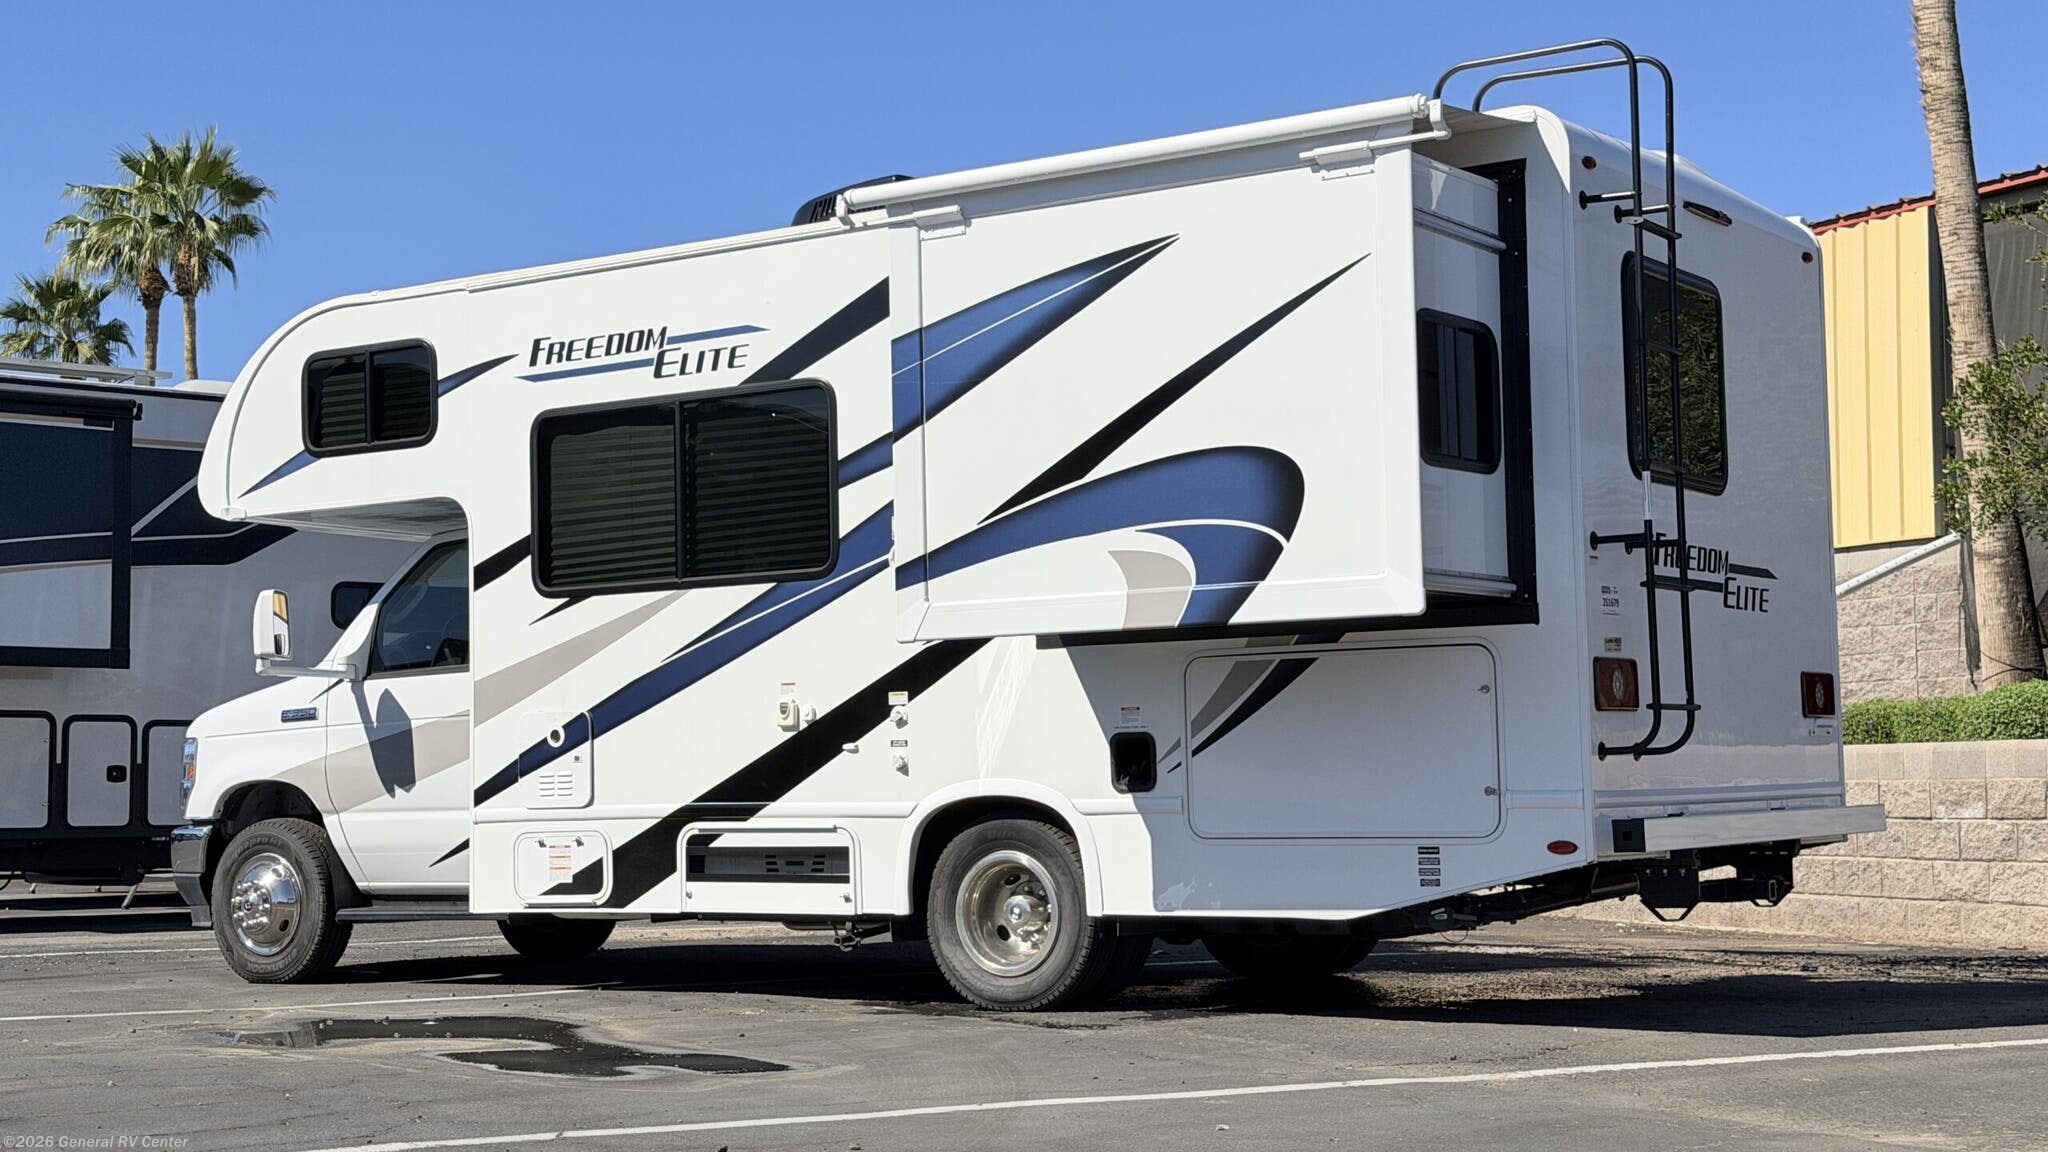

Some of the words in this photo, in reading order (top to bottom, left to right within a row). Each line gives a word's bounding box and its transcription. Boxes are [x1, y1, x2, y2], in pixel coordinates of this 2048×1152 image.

[528, 326, 668, 368] FREEDOM
[653, 343, 751, 379] ELITE
[1722, 576, 1770, 614] ELITE
